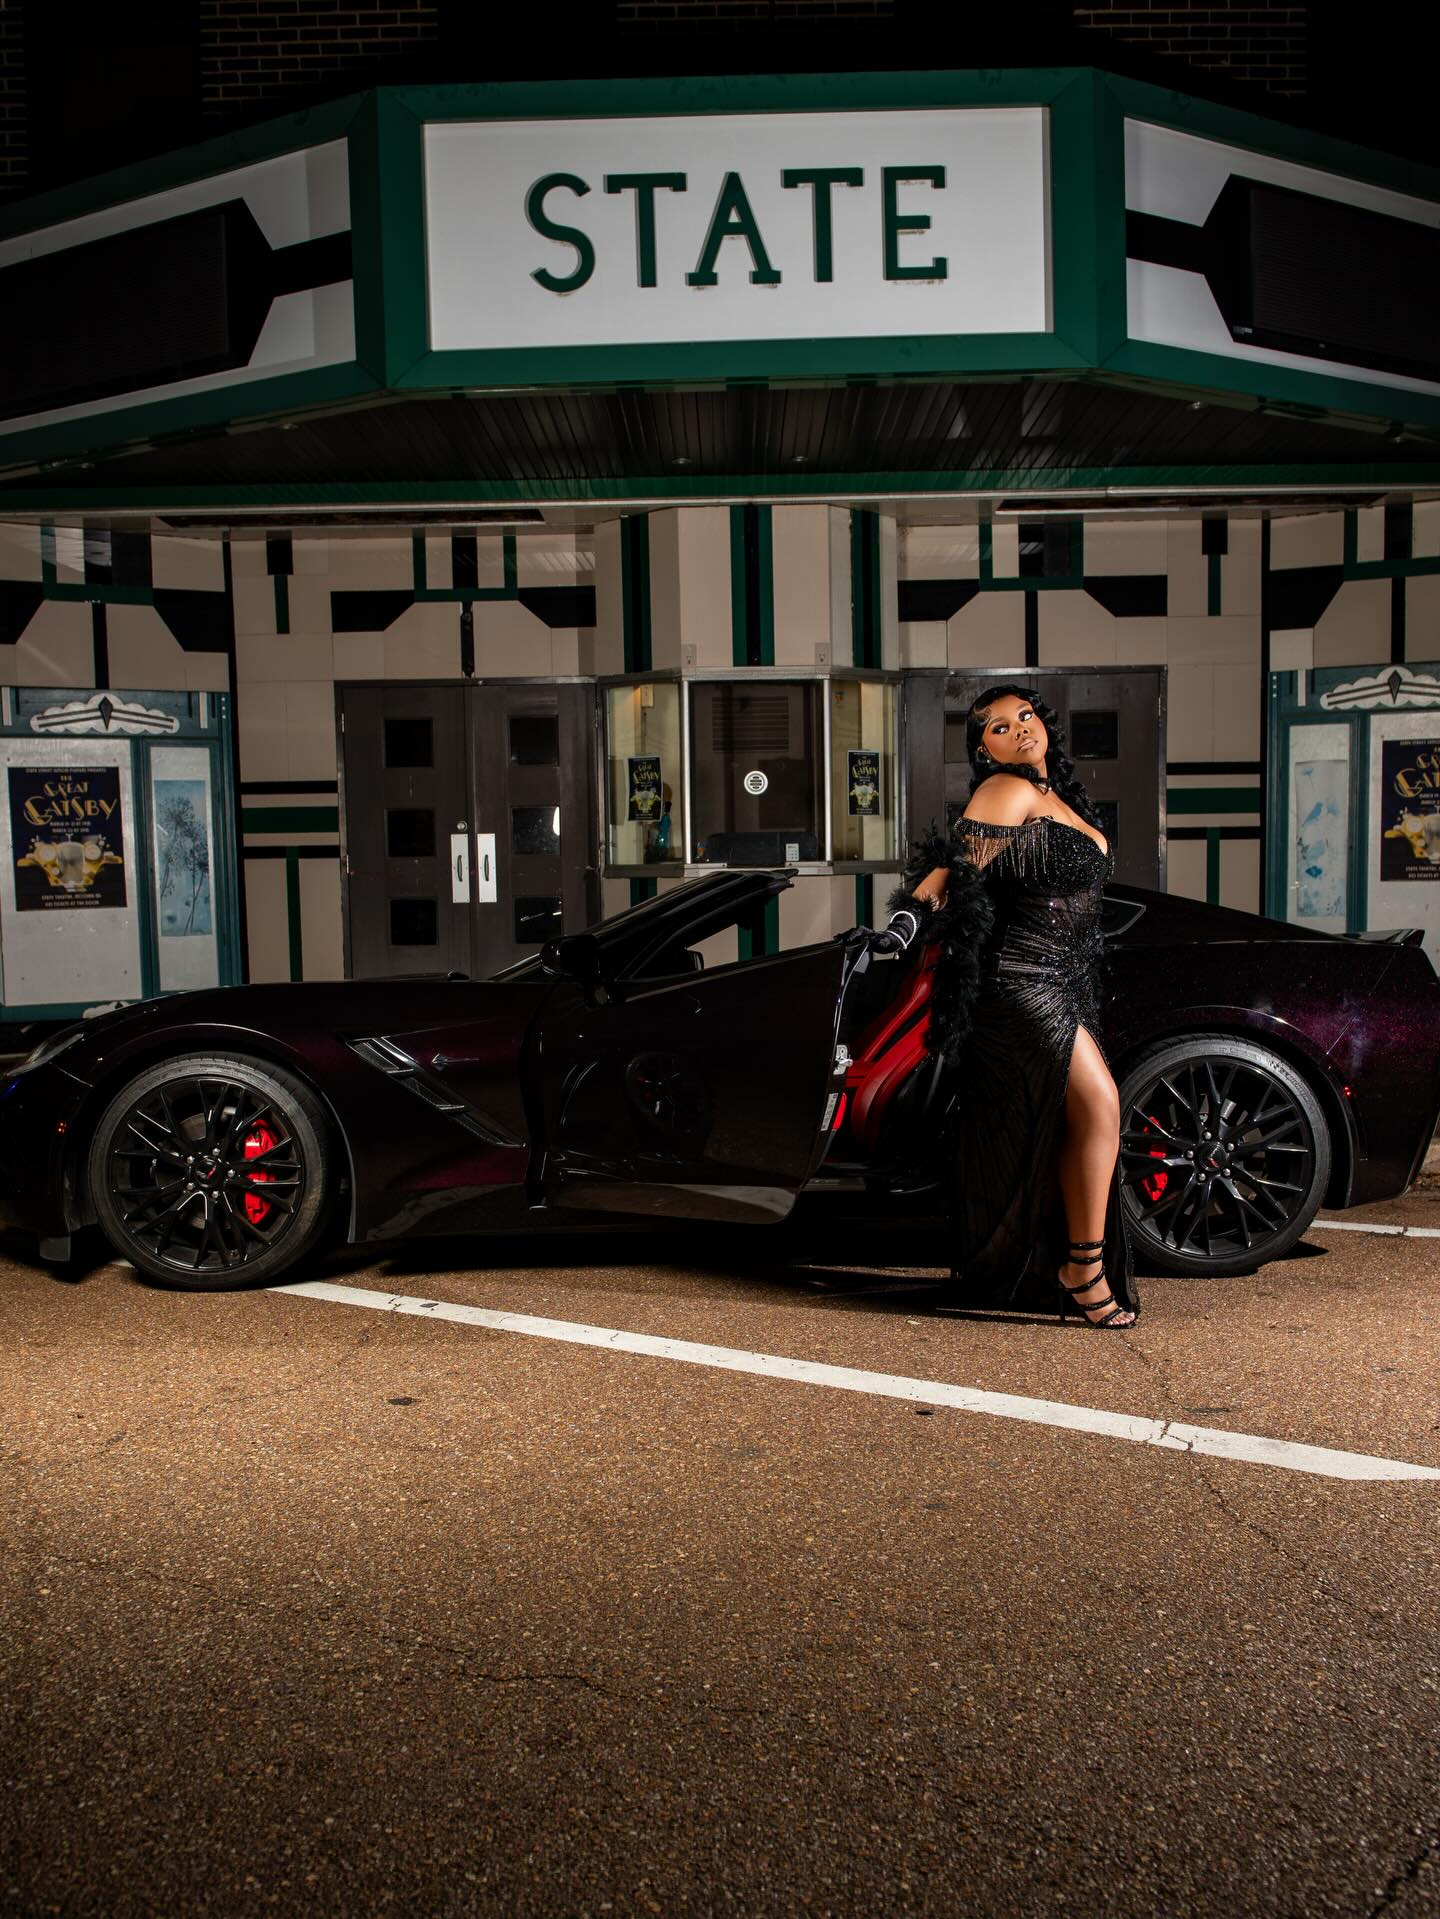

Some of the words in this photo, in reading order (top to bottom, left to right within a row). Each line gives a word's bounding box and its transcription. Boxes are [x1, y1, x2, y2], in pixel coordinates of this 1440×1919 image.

[524, 164, 949, 294] STATE
[43, 781, 89, 799] GREAT
[23, 796, 117, 826] GATSBY
